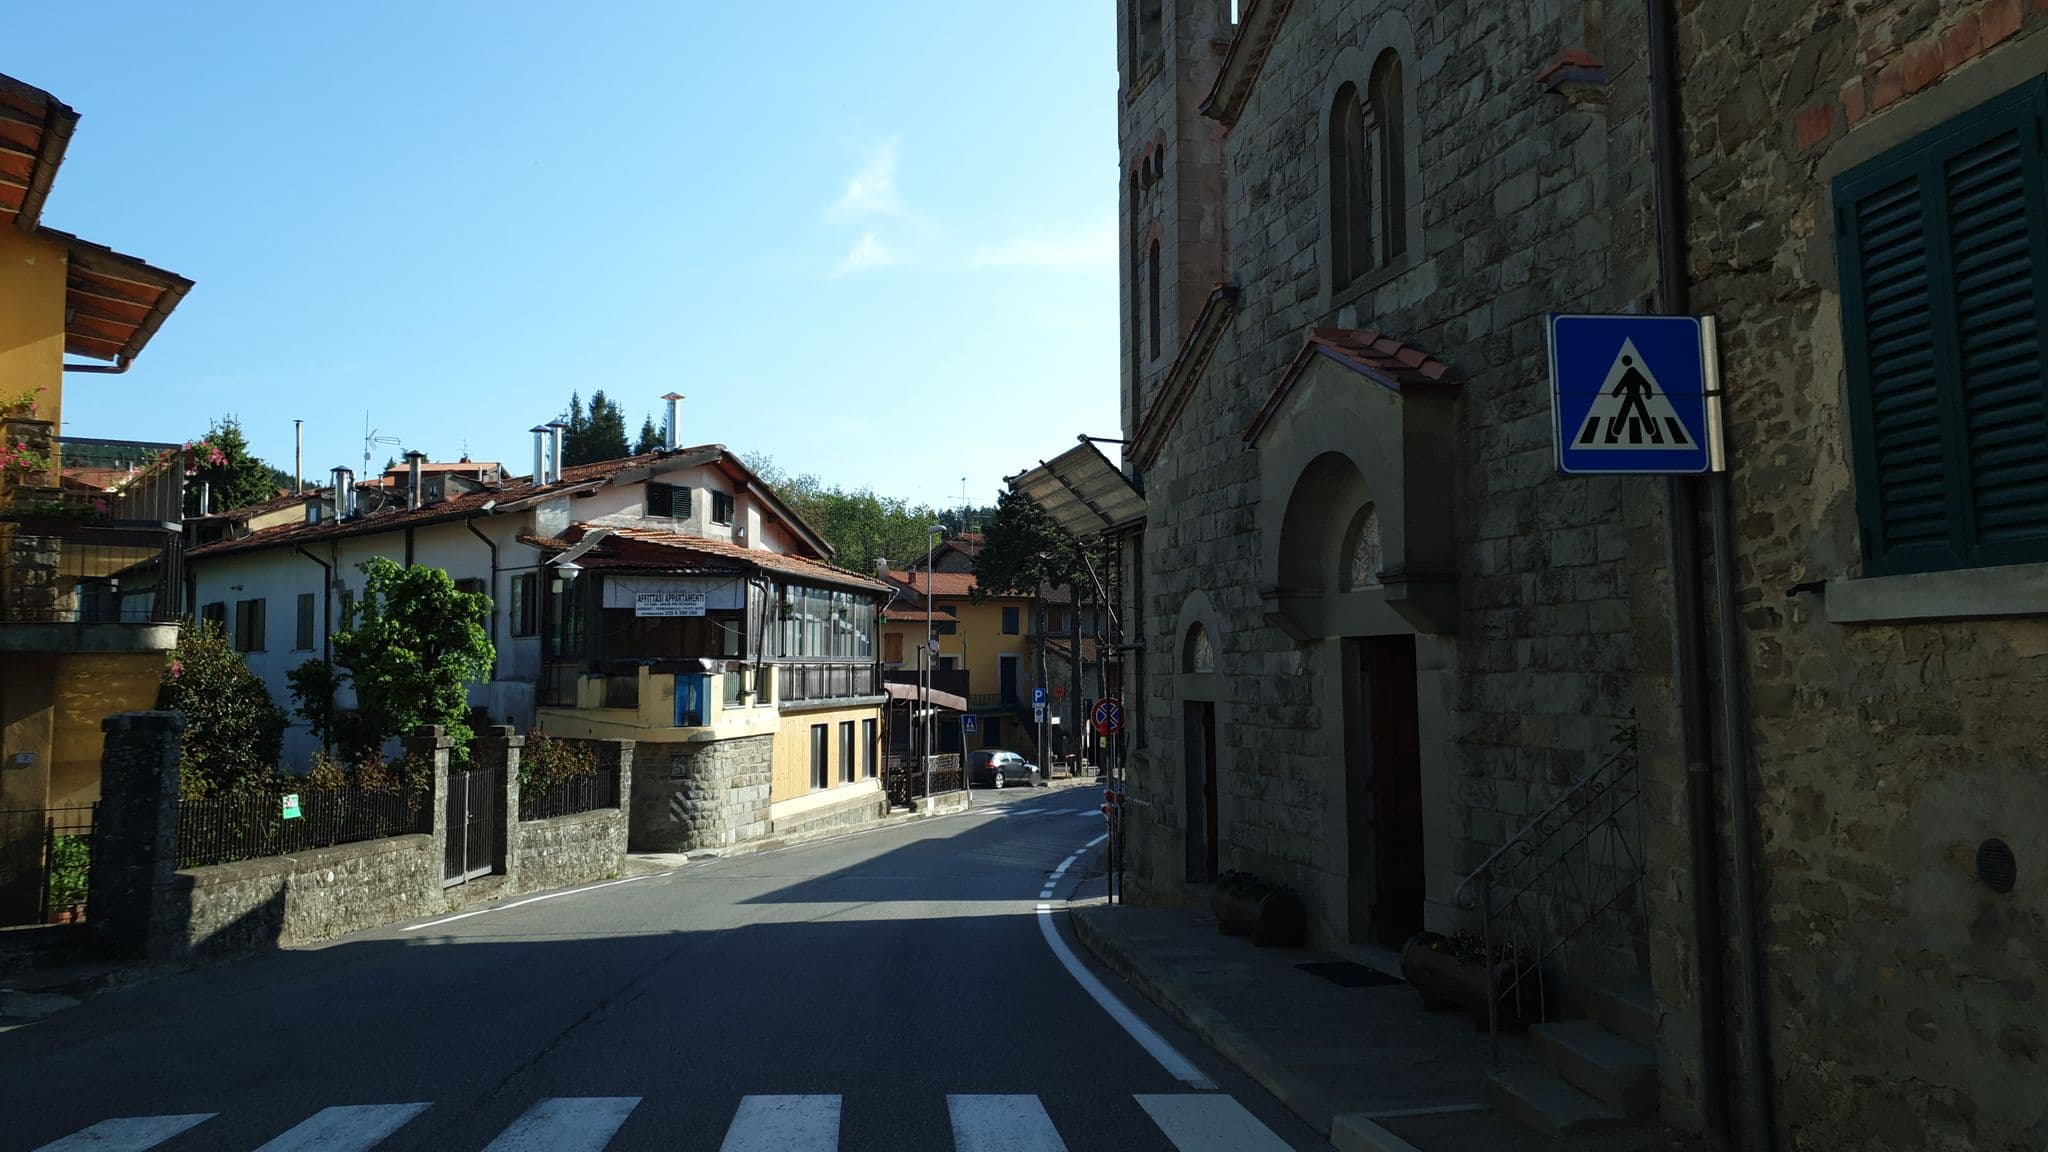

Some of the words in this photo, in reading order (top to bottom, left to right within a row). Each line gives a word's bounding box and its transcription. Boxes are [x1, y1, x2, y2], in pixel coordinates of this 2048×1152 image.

[638, 594, 663, 602] AFFITTASI
[665, 593, 704, 602] APPARTAMENTI
[1034, 689, 1043, 702] P
